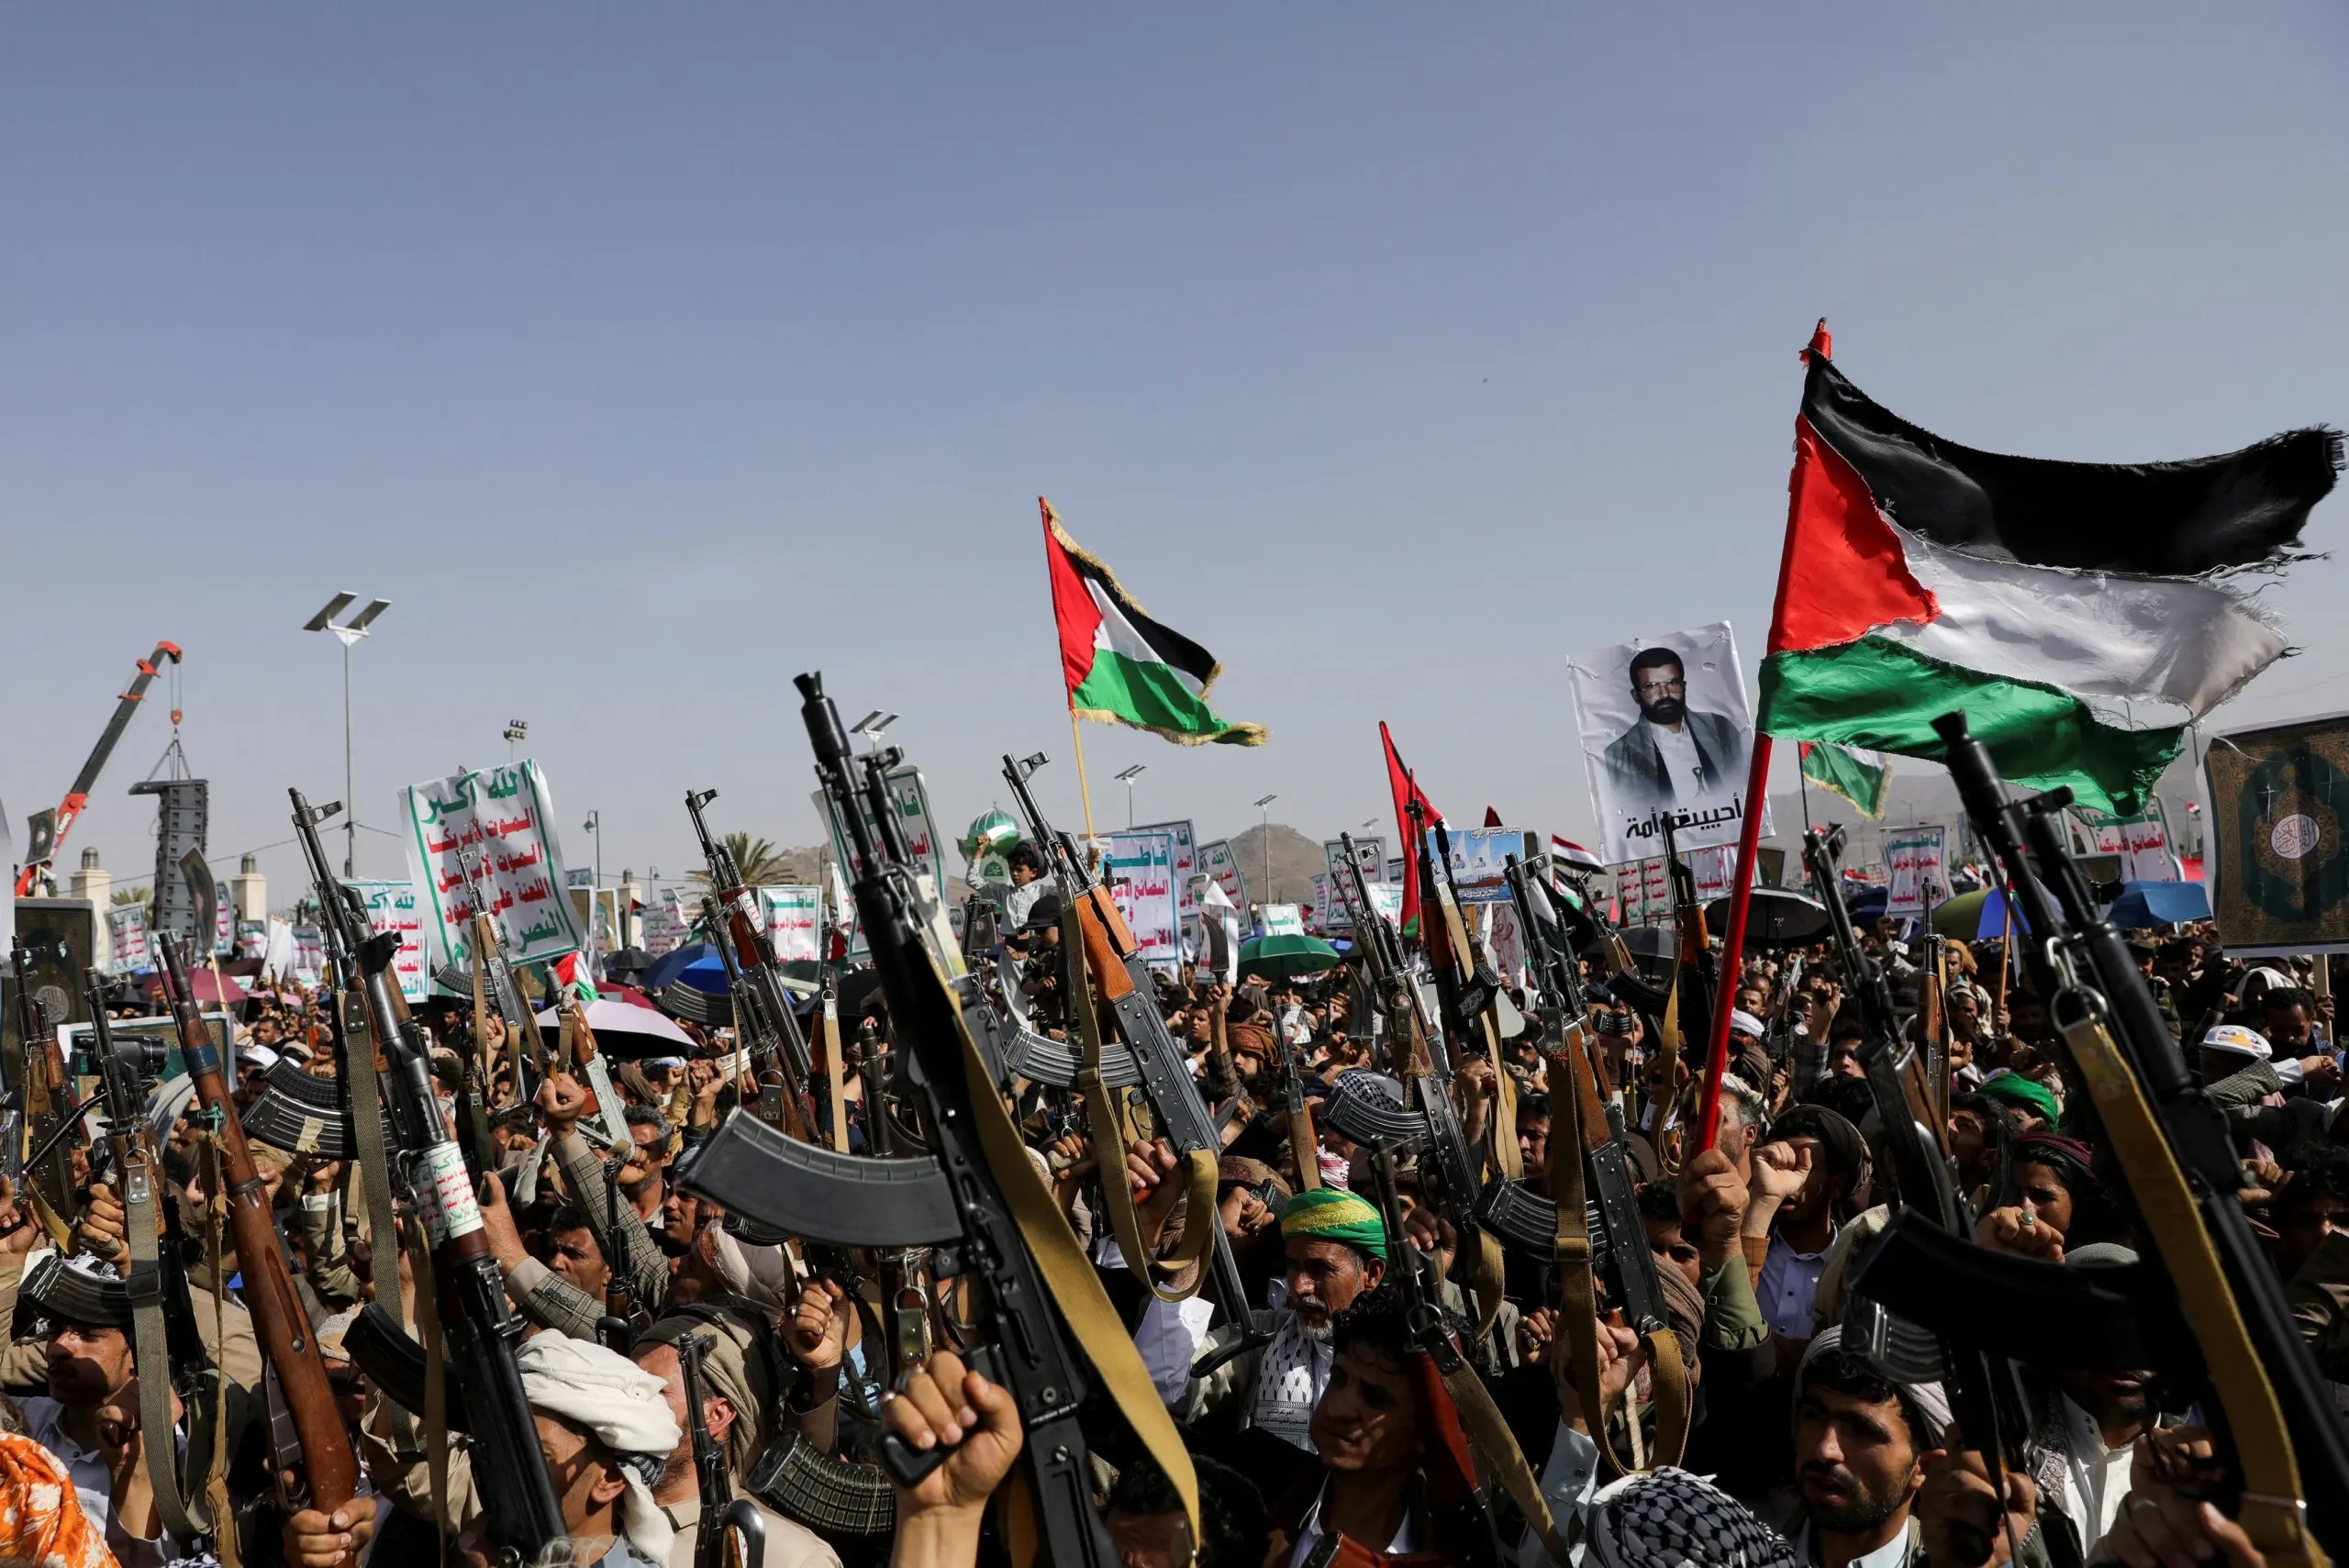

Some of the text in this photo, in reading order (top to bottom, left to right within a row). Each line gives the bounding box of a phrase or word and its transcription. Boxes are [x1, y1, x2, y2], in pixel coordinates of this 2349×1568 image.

[488, 761, 528, 799] الله
[485, 806, 536, 840] الموت
[1626, 807, 1660, 840] أمة
[438, 840, 543, 894] الموت لإسرئيل
[1097, 844, 1168, 875] قاطع
[395, 890, 416, 910] لله
[518, 908, 566, 955] النصر
